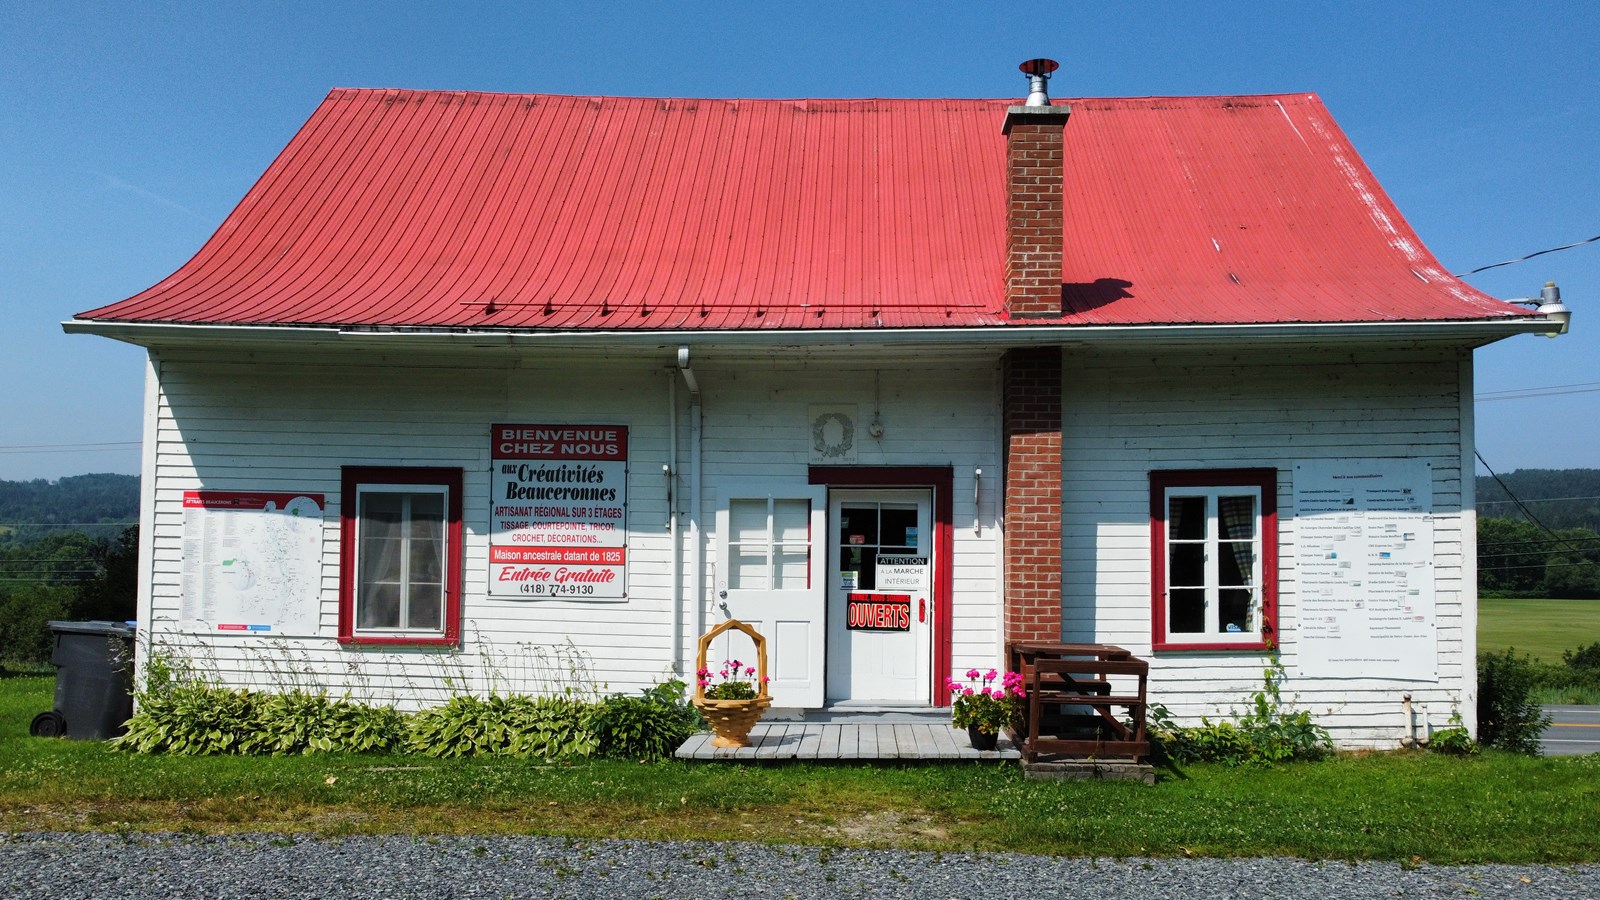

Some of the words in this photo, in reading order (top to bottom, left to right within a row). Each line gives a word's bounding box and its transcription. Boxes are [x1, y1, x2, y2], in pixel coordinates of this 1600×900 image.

[502, 429, 617, 441] BIENVENUE
[500, 443, 555, 454] CHEZ
[561, 443, 619, 455] NOUS
[502, 464, 517, 474] aux
[518, 463, 604, 483] Créativités
[506, 481, 617, 502] Beauceronnes
[494, 506, 533, 517] ARTISANAT
[534, 504, 571, 518] RÉGIONAL
[572, 507, 587, 518] SUR
[588, 507, 593, 518] 3
[594, 505, 622, 518] ÉTAGES
[500, 521, 531, 530] TISSAGE,
[532, 521, 588, 531] COURTEPOINTE,
[589, 522, 616, 531] TRICOT,
[512, 534, 546, 543] CROCHET,
[494, 549, 522, 560] Maison
[522, 550, 562, 561] ancestrale
[563, 550, 588, 561] datant
[589, 550, 600, 561] de
[601, 551, 621, 562] 1825
[498, 566, 552, 582] Entrée
[554, 567, 616, 584] Gratuite
[520, 584, 545, 594] (418)
[548, 584, 594, 595] 774-9130
[848, 602, 910, 629] OUVERTS
